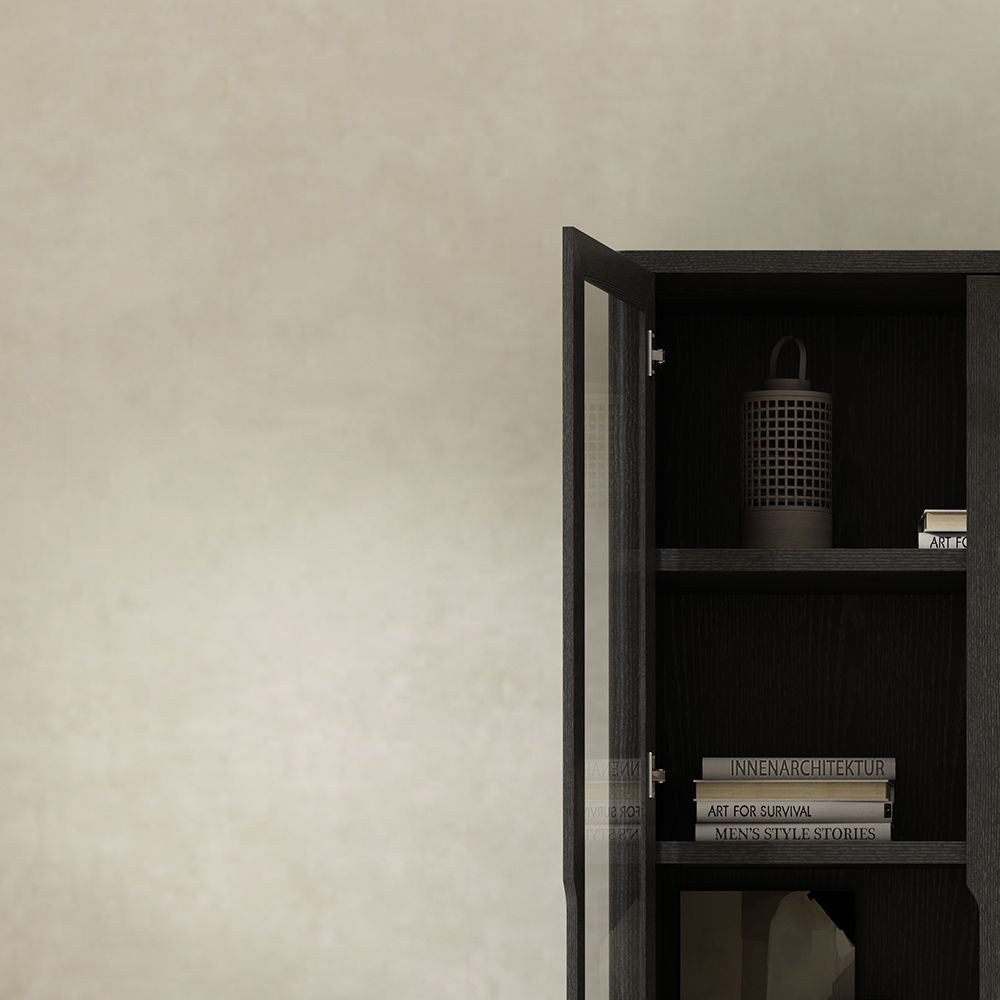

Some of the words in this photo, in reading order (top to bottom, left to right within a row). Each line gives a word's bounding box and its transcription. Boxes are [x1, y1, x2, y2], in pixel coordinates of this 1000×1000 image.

[930, 536, 952, 548] ART
[731, 760, 885, 776] INNENARCHITEKTUR
[707, 805, 729, 817] ART
[734, 805, 757, 817] FOR
[760, 805, 812, 817] SURVIVAL
[715, 827, 760, 840] MEN'S
[764, 827, 810, 840] STYLE
[813, 827, 876, 840] STORIES
